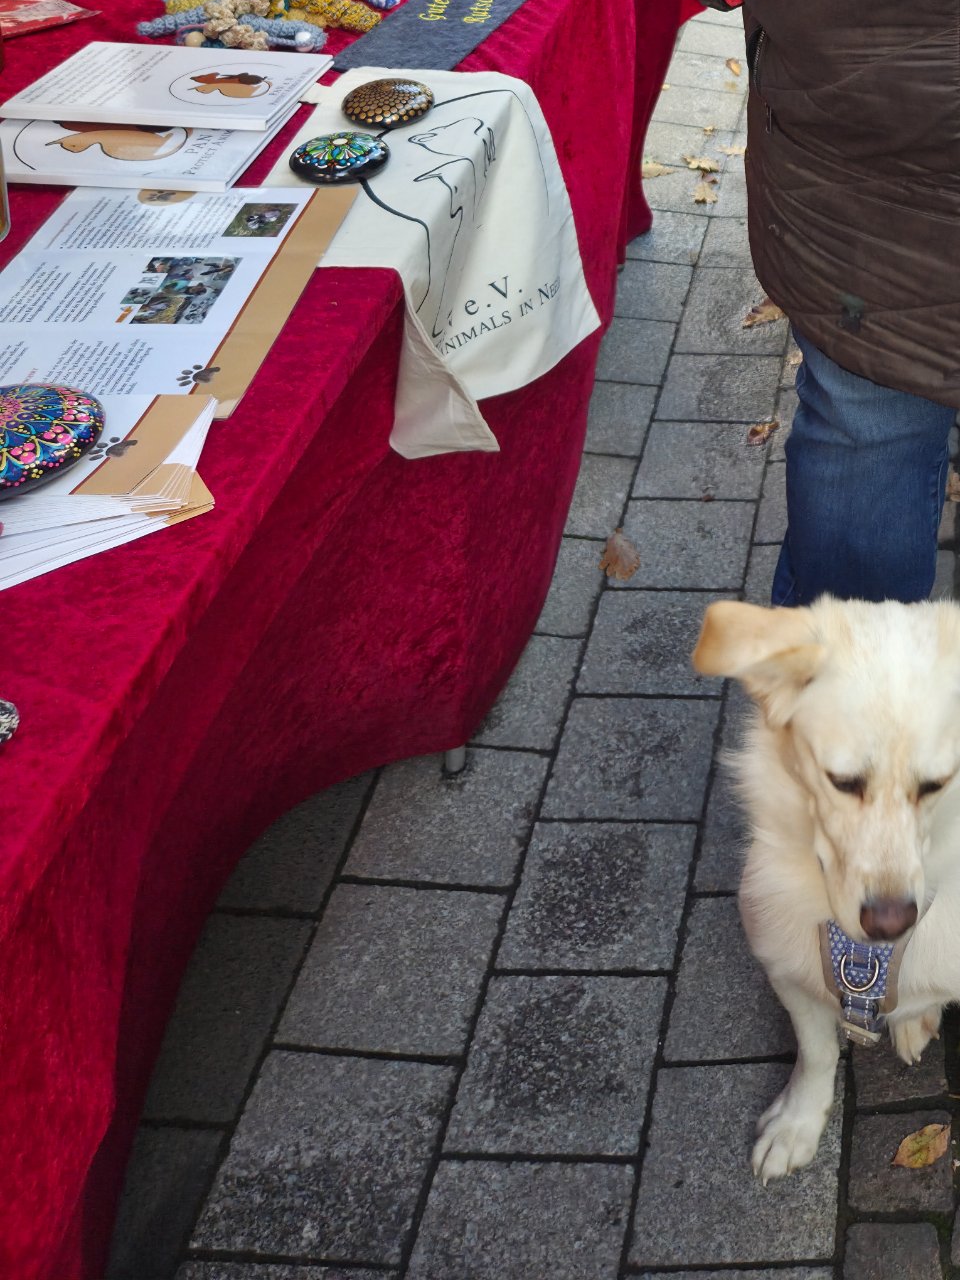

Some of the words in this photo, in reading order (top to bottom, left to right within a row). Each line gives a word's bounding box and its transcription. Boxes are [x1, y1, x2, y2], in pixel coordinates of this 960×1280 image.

[184, 134, 213, 154] PAN
[211, 129, 235, 146] ANIM
[519, 298, 534, 318] IN
